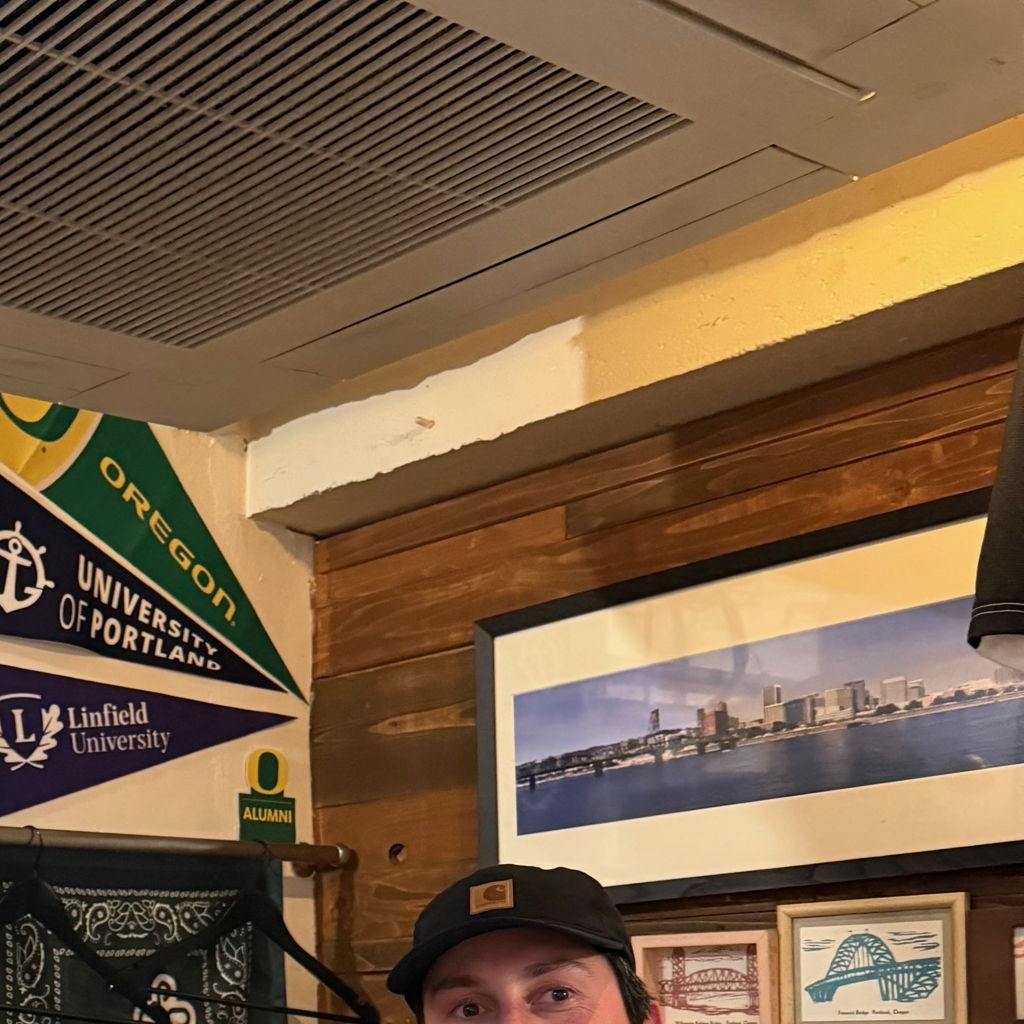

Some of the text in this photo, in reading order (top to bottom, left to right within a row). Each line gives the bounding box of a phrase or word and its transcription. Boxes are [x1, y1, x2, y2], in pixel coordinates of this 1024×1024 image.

[98, 456, 237, 622] OREGON
[77, 554, 218, 656] UNIVERSITY
[59, 593, 222, 671] OF PORTLAND
[11, 708, 37, 743] L
[67, 701, 150, 729] Linfield
[70, 729, 171, 754] University
[242, 806, 293, 824] ALUMNI
